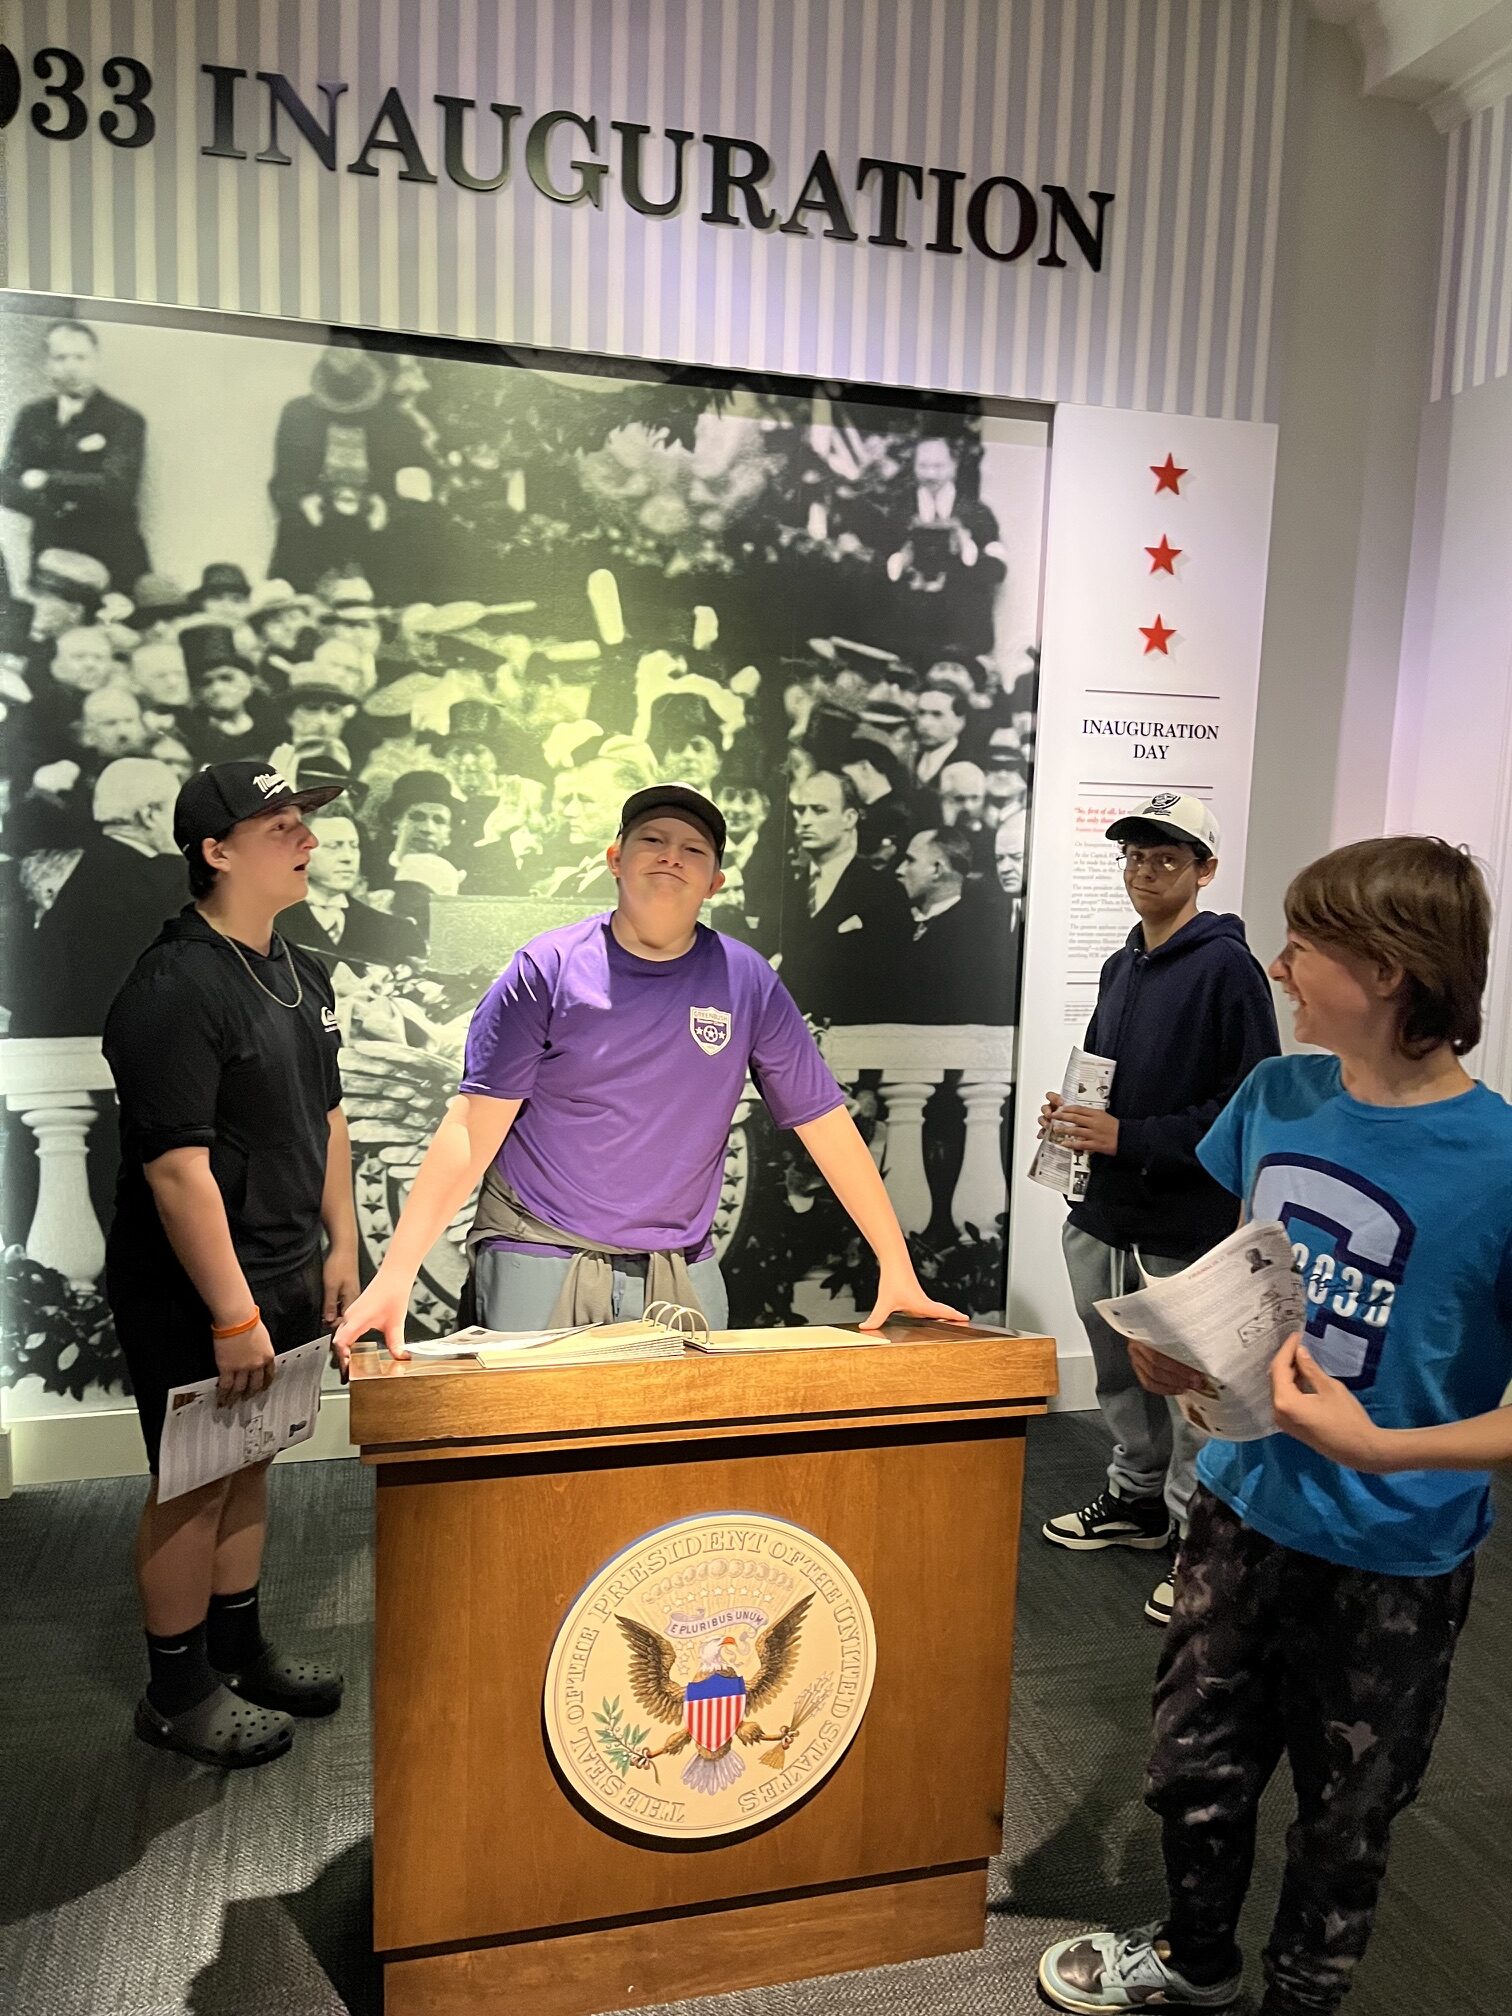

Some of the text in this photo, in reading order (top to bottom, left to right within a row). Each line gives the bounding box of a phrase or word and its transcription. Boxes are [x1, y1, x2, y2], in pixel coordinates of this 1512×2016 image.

[201, 63, 1115, 272] INAUGURATION
[1082, 719, 1219, 740] INAUGURATION
[1133, 743, 1169, 760] DAY
[670, 1610, 764, 1635] E PLURIBUS UNUM
[565, 1529, 862, 1824] THE SEAL OF THE PRESIDENT OF THE UNITED STATES
